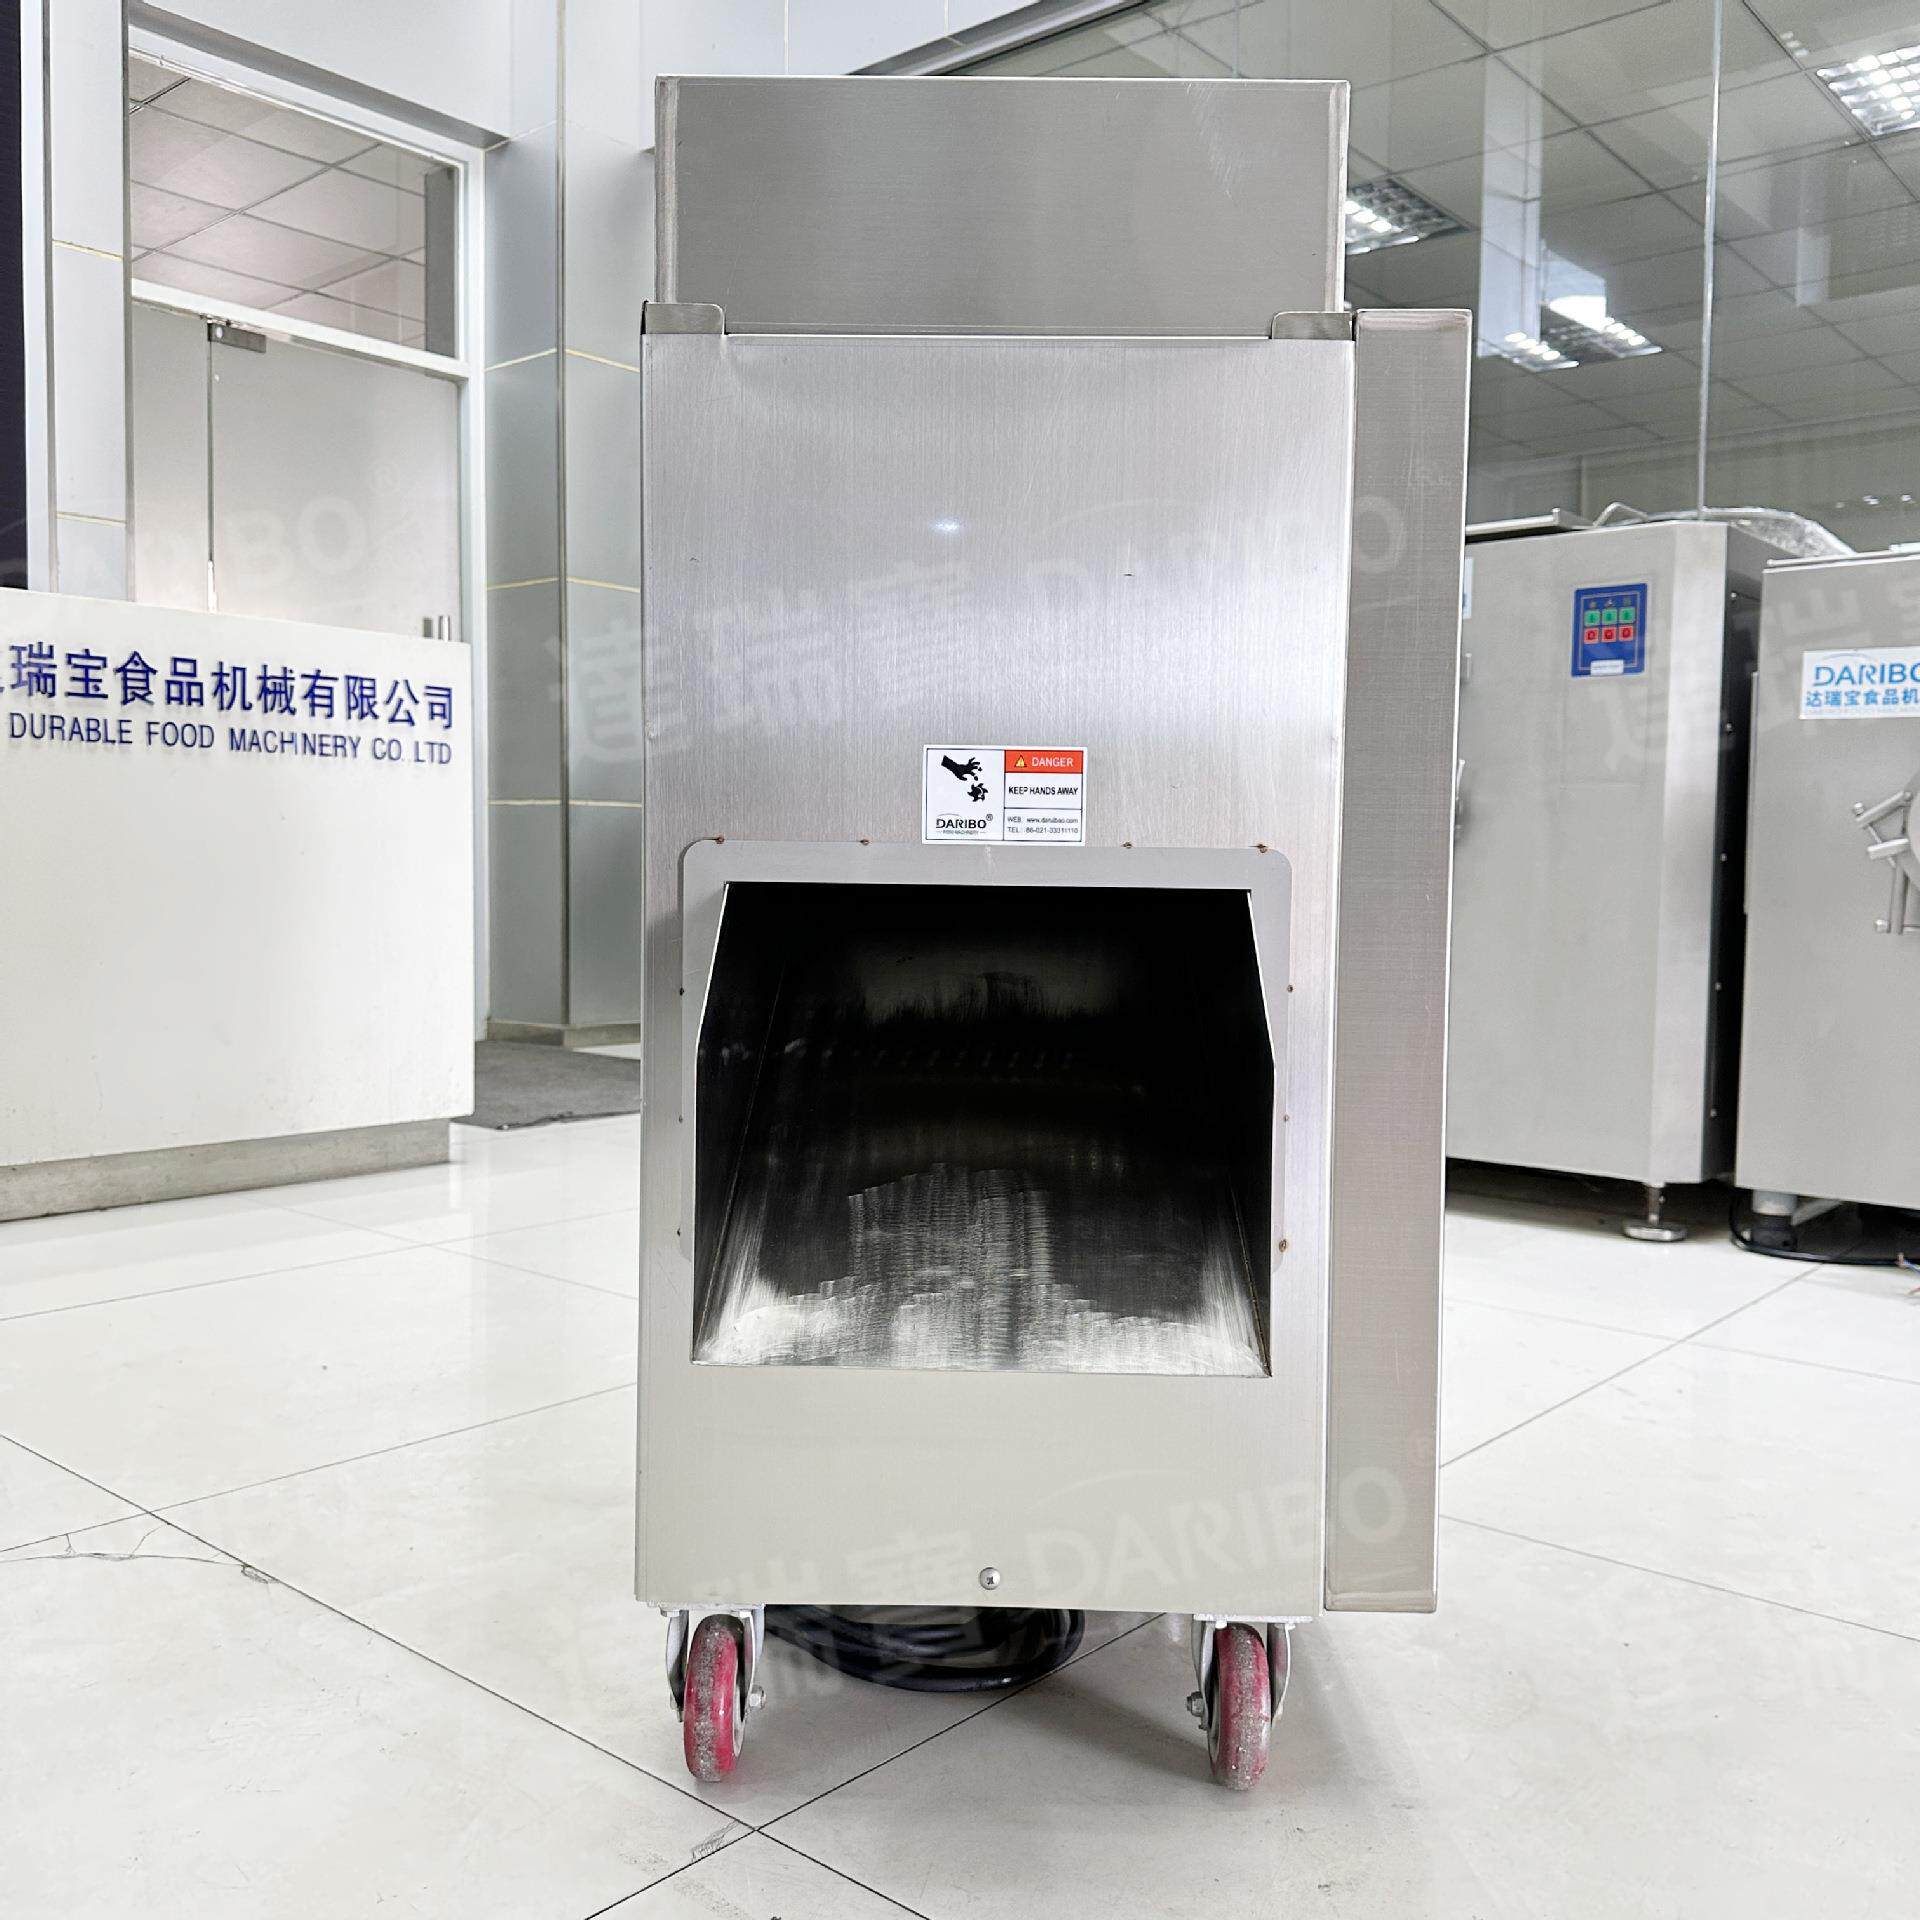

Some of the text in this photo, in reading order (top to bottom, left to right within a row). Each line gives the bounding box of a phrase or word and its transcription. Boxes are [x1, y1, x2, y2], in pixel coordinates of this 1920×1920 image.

[0, 641, 453, 730] 瑞宝食品机械有限公司
[9, 712, 133, 745] DURABLE
[145, 721, 215, 749] FOOD
[229, 729, 361, 759] MACHINERY
[1031, 756, 1074, 767] DANGER
[1008, 786, 1079, 795] KEEP HANDS AWAY
